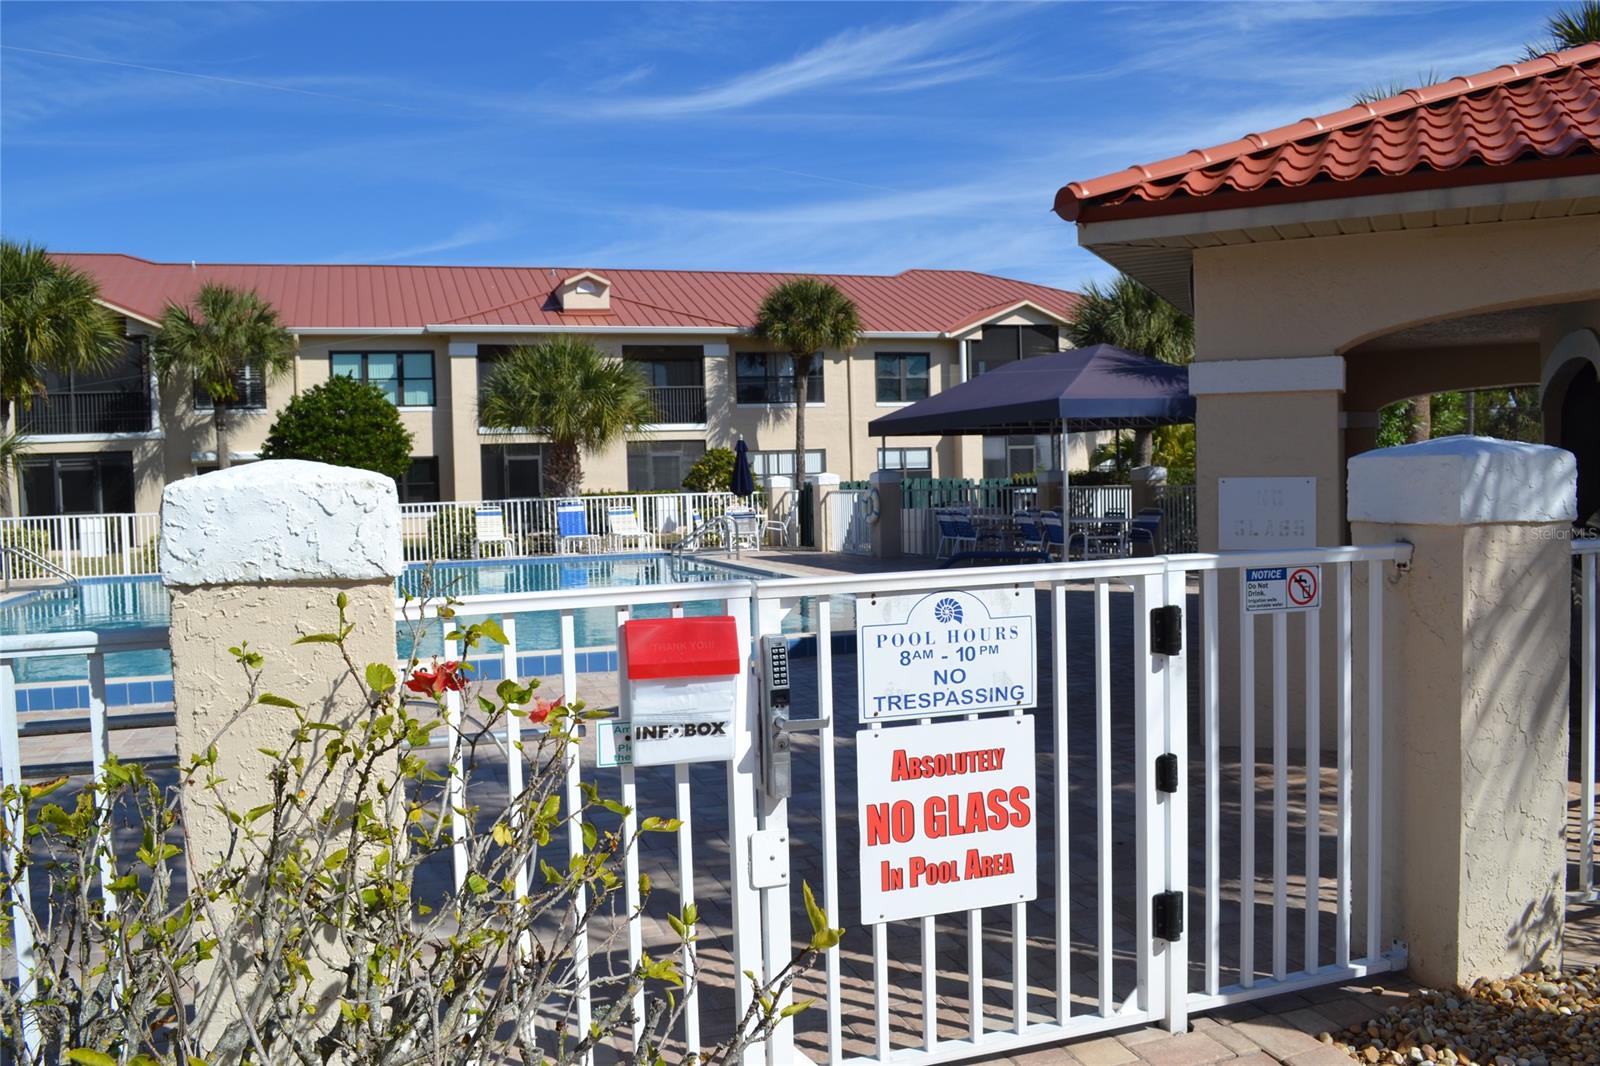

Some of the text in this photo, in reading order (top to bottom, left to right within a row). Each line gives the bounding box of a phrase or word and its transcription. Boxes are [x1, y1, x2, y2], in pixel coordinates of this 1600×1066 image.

[1251, 569, 1281, 579] NOTICE
[877, 625, 1019, 649] POOL HOURS
[934, 669, 966, 685] NO
[873, 685, 1025, 712] TRESPASSING
[891, 748, 1005, 782] ABSOLUTELY
[867, 786, 1031, 846] NO GLASS
